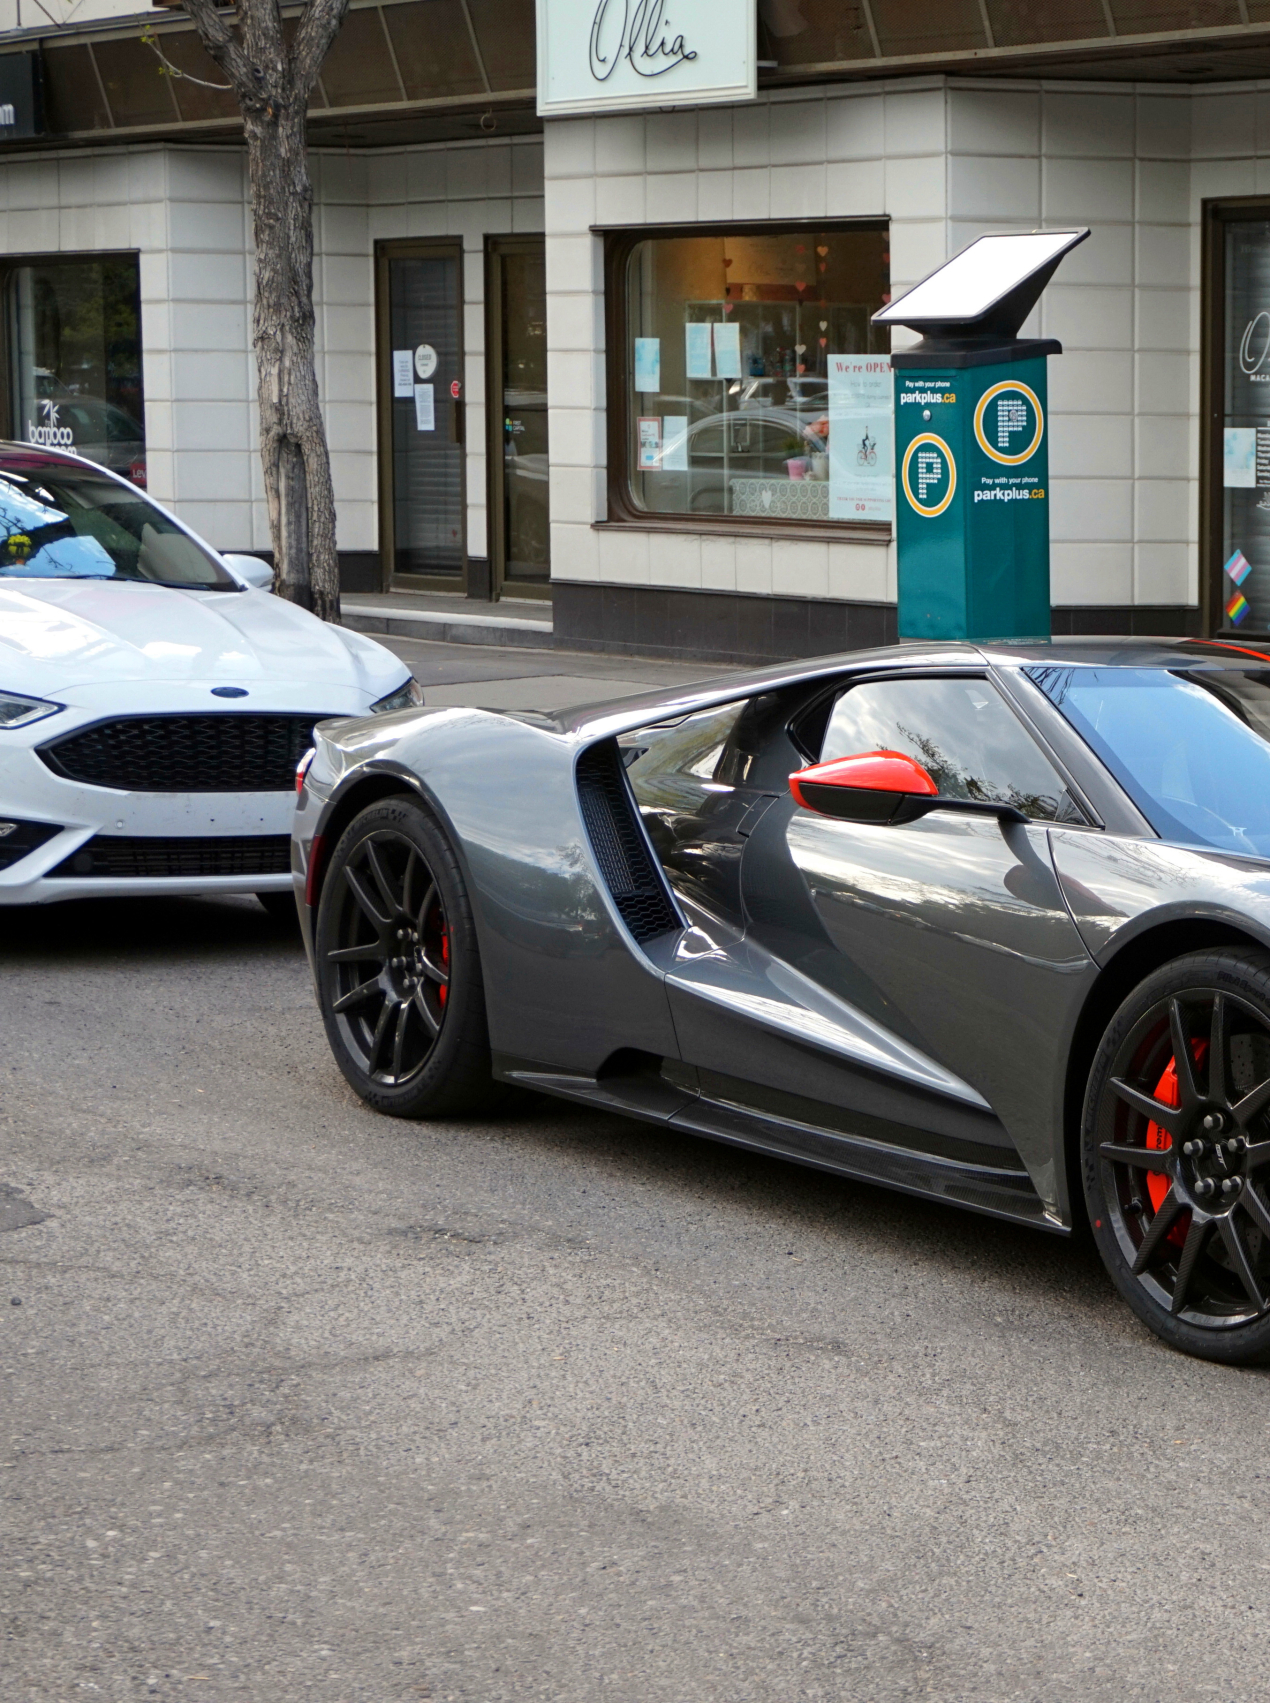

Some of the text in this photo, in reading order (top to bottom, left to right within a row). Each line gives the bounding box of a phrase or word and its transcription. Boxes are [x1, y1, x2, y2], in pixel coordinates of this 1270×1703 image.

[589, 0, 698, 81] Ollia
[835, 361, 863, 373] We're
[905, 380, 914, 388] Pay
[900, 390, 956, 406] parkplus.ca
[28, 420, 73, 446] bamboo
[981, 477, 993, 485] Pay
[1008, 477, 1021, 485] your
[1021, 476, 1039, 485] phone
[974, 486, 1045, 503] parkplus.ca
